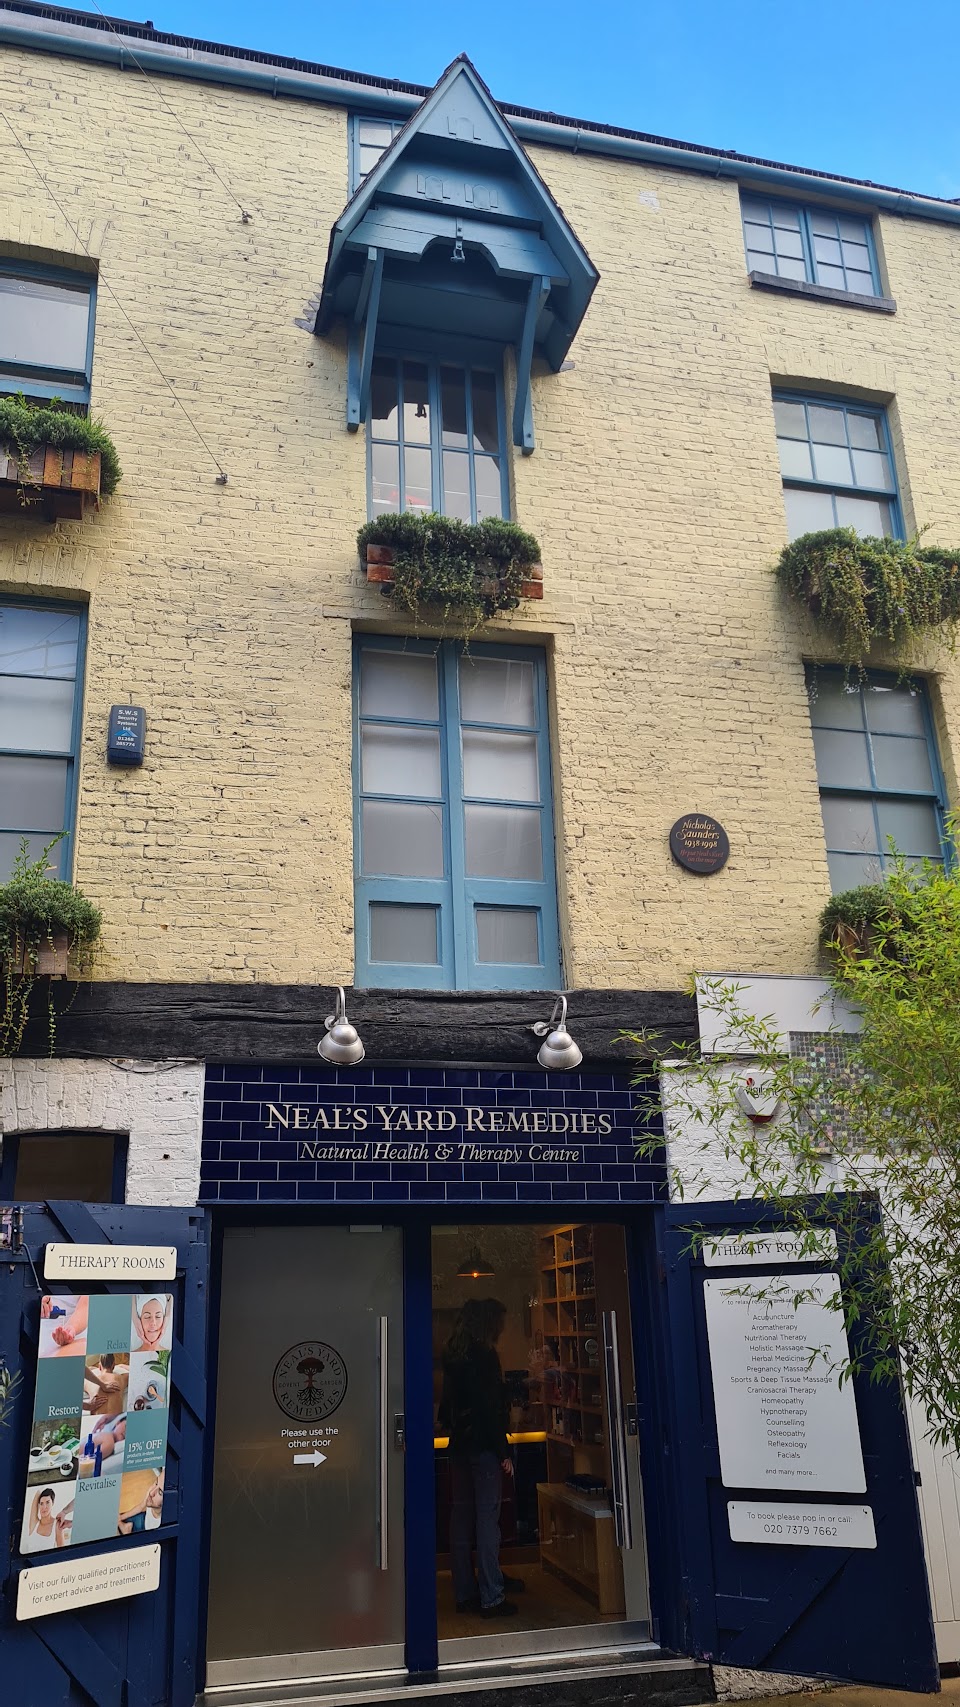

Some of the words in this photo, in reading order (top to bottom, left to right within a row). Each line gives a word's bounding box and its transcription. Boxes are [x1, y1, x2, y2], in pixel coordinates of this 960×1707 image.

[682, 818, 716, 830] Nicholas
[675, 829, 720, 840] Saunders
[265, 1104, 368, 1130] NEAL'S
[375, 1106, 457, 1131] YARD
[465, 1107, 612, 1134] REMEDIES
[300, 1142, 369, 1160] Natural
[373, 1143, 429, 1160] Health
[434, 1144, 453, 1161] &
[457, 1144, 522, 1164] Therapy
[528, 1145, 580, 1161] Centre
[59, 1255, 119, 1268] THERAPY
[122, 1257, 165, 1269] ROOMS
[106, 1339, 128, 1350] Relax
[317, 1348, 341, 1376] YARD
[280, 1389, 340, 1416] REMEDIES
[761, 1397, 804, 1405] Homeopathy
[48, 1405, 79, 1417] Restore
[760, 1408, 807, 1416] Hypnotherapy
[766, 1418, 805, 1426] Counselling
[281, 1428, 307, 1437] Please
[309, 1428, 323, 1436] use
[325, 1427, 339, 1435] the
[766, 1429, 806, 1437] Osteopathy
[145, 1439, 162, 1450] OFF
[288, 1440, 310, 1448] other
[767, 1440, 807, 1449] Reflexology
[777, 1451, 800, 1459] Facials
[78, 1478, 117, 1493] Revitalise
[746, 1511, 755, 1519] To
[757, 1512, 775, 1520] book
[777, 1513, 800, 1522] please
[763, 1524, 783, 1533] 020
[786, 1525, 810, 1535] 7379
[813, 1526, 838, 1536] 7662
[28, 1580, 44, 1591] Visit
[46, 1578, 60, 1588] our
[60, 1575, 76, 1585] fully
[77, 1567, 108, 1581] qualified
[109, 1560, 151, 1576] practitioners
[32, 1595, 43, 1604] for
[45, 1589, 68, 1602] expert
[70, 1584, 94, 1597] advice
[95, 1581, 108, 1591] and
[109, 1573, 146, 1587] treatments
